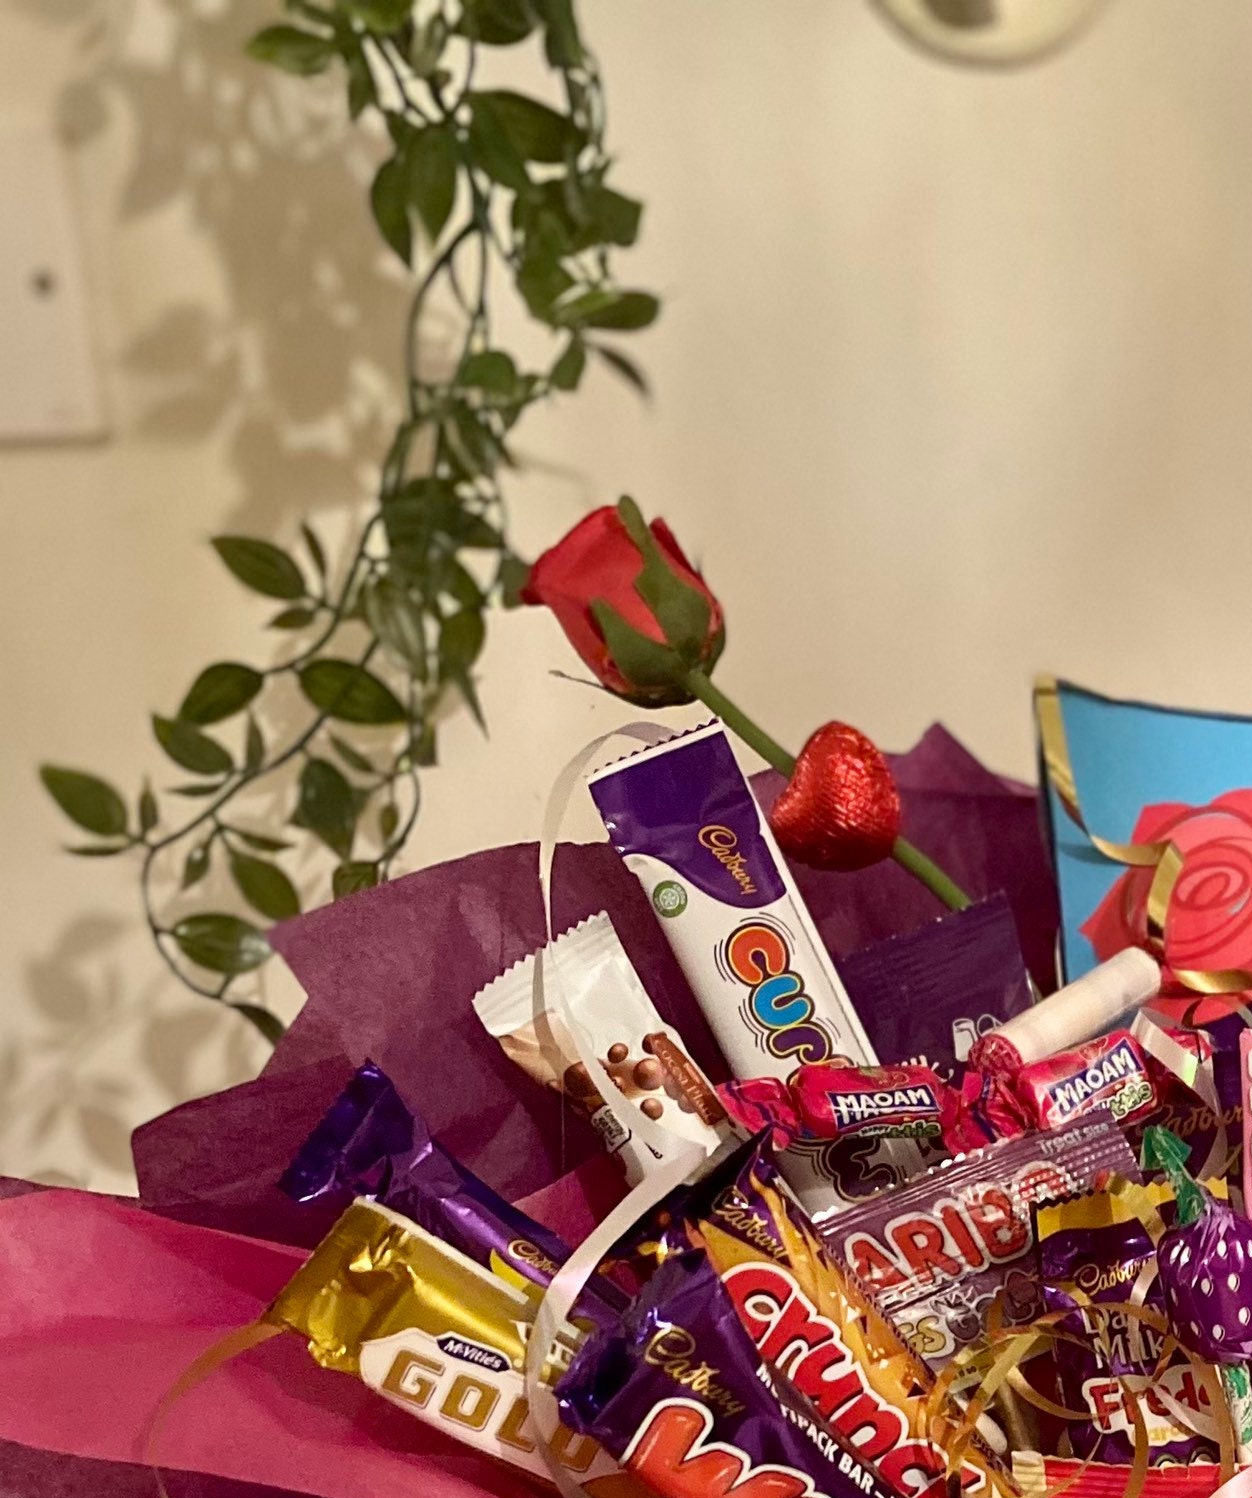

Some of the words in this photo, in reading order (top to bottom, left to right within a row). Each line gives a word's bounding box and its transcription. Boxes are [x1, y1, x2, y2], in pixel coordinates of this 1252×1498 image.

[698, 824, 758, 896] Cadbury
[836, 1086, 932, 1121] MAOAM
[1056, 1047, 1138, 1111] MAOAM
[1036, 1130, 1082, 1155] Treat
[1082, 1122, 1111, 1140] size
[643, 1324, 747, 1419] Cadbury
[837, 1452, 875, 1495] BAR
